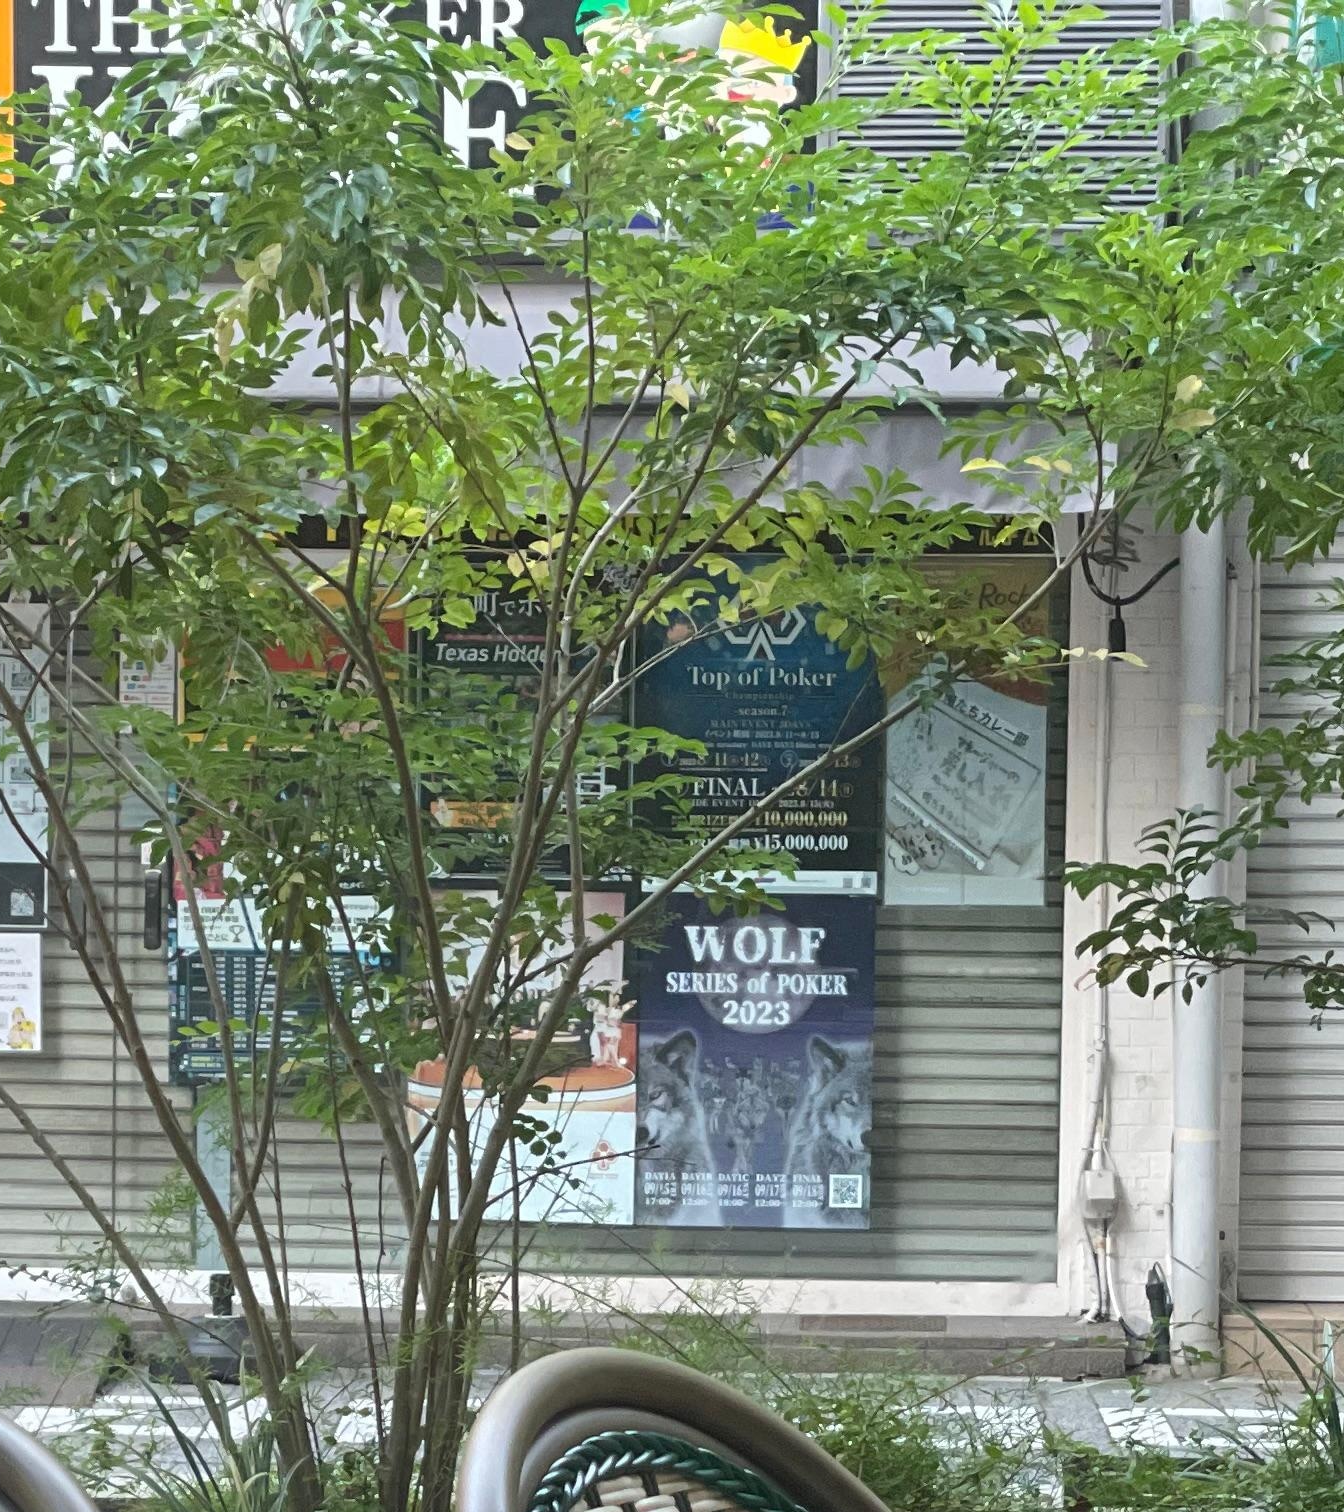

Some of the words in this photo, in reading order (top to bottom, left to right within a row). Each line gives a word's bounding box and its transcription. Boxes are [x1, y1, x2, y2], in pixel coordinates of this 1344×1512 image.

[435, 643, 489, 662] Texas
[686, 666, 731, 690] Top
[737, 666, 764, 686] of
[769, 667, 838, 687] Poker
[684, 925, 827, 965] WOLF
[666, 971, 739, 994] SERIES
[746, 972, 769, 995] of
[776, 973, 848, 996] POKER
[722, 1000, 791, 1026] 2023
